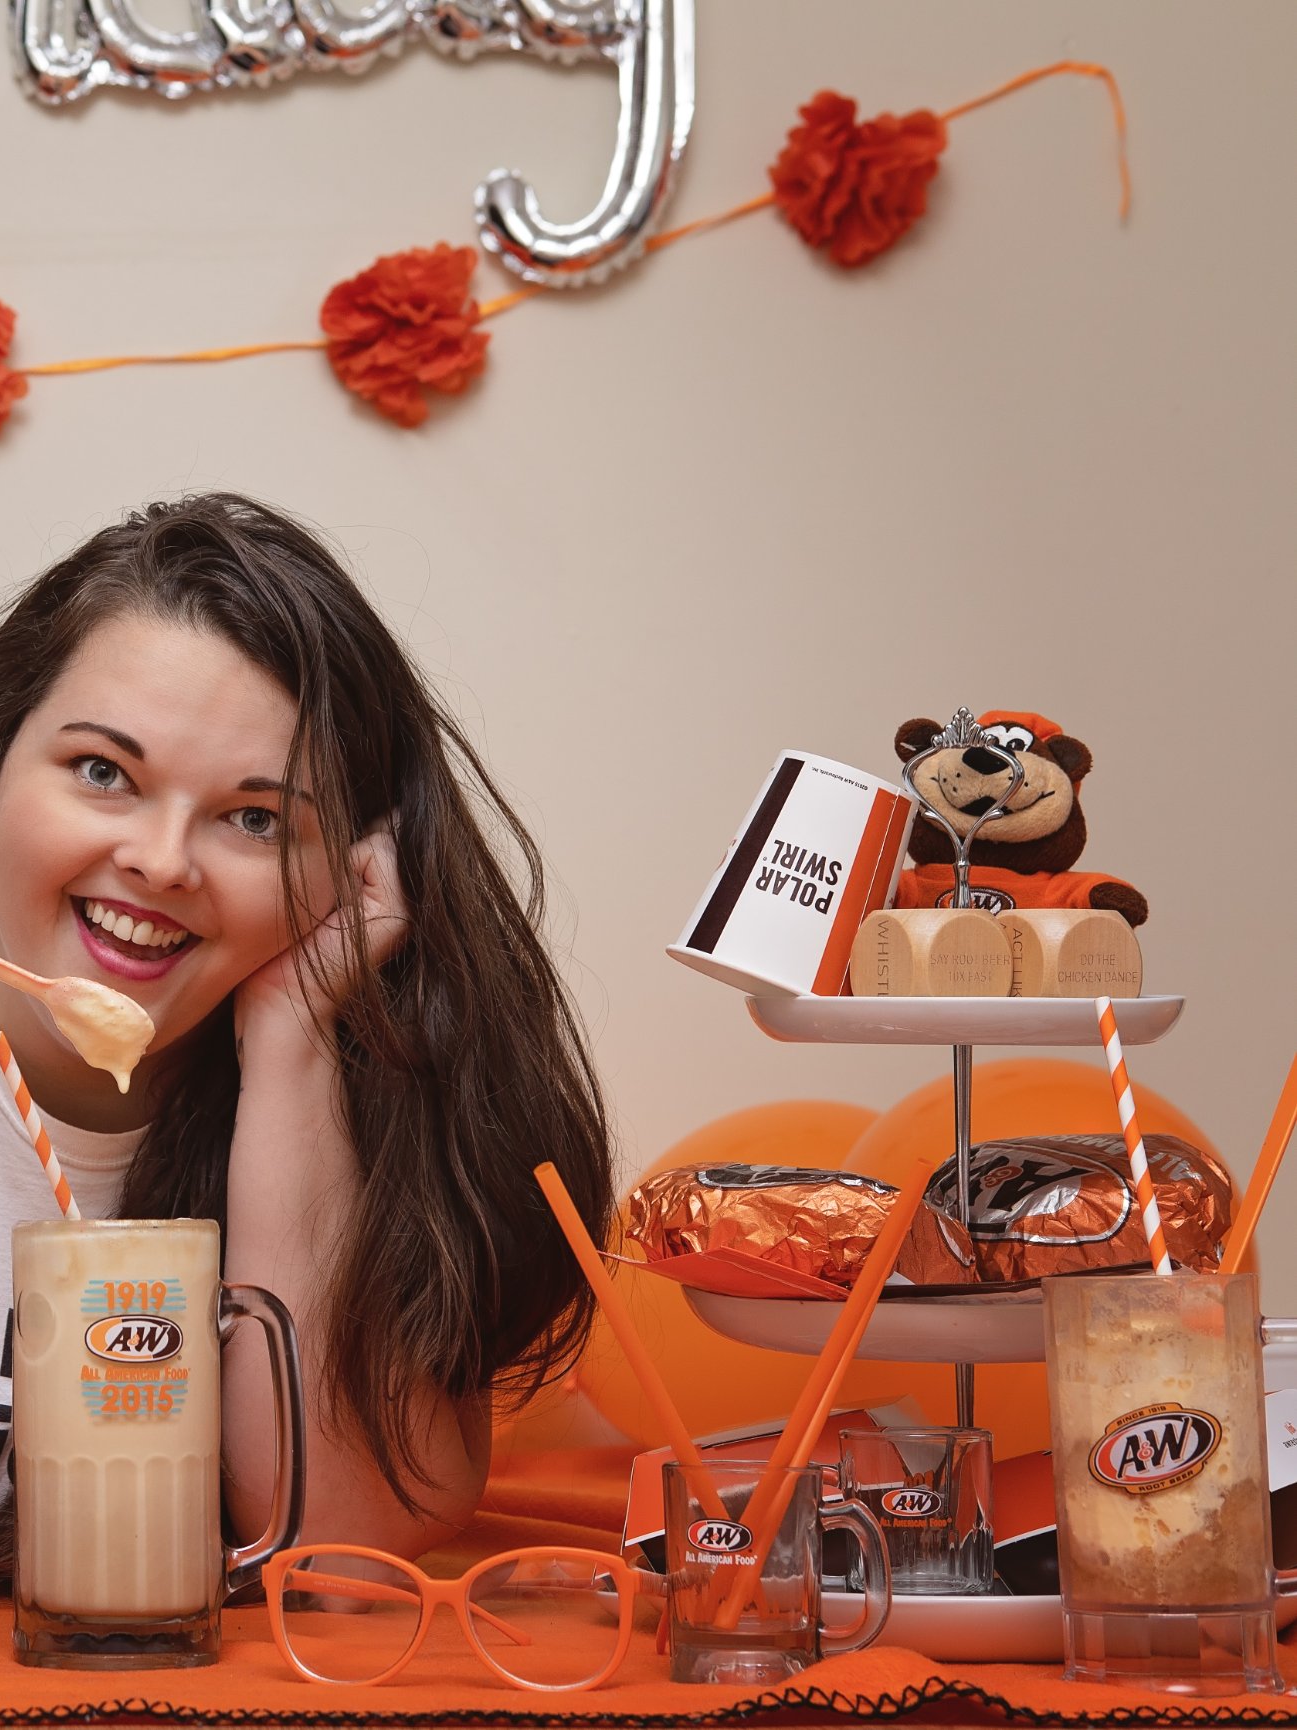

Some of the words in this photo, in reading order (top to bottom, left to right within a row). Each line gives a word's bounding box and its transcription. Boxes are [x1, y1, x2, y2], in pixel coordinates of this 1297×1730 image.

[755, 866, 834, 915] POLAR
[982, 953, 1011, 966] BEER
[1012, 927, 1023, 965] ACT
[1080, 953, 1094, 966] DO
[1097, 953, 1116, 966] THE
[1057, 971, 1102, 984] CHICKEN
[1104, 971, 1139, 984] DANCE
[103, 1281, 167, 1311] 1919
[105, 1325, 171, 1353] A&W
[100, 1383, 175, 1413] 2015
[1116, 1410, 1145, 1427] SINCE
[1148, 1405, 1167, 1415] 1919
[1116, 1416, 1193, 1480] A&W
[1138, 1481, 1167, 1493] ROOT
[1169, 1469, 1195, 1485] BEER
